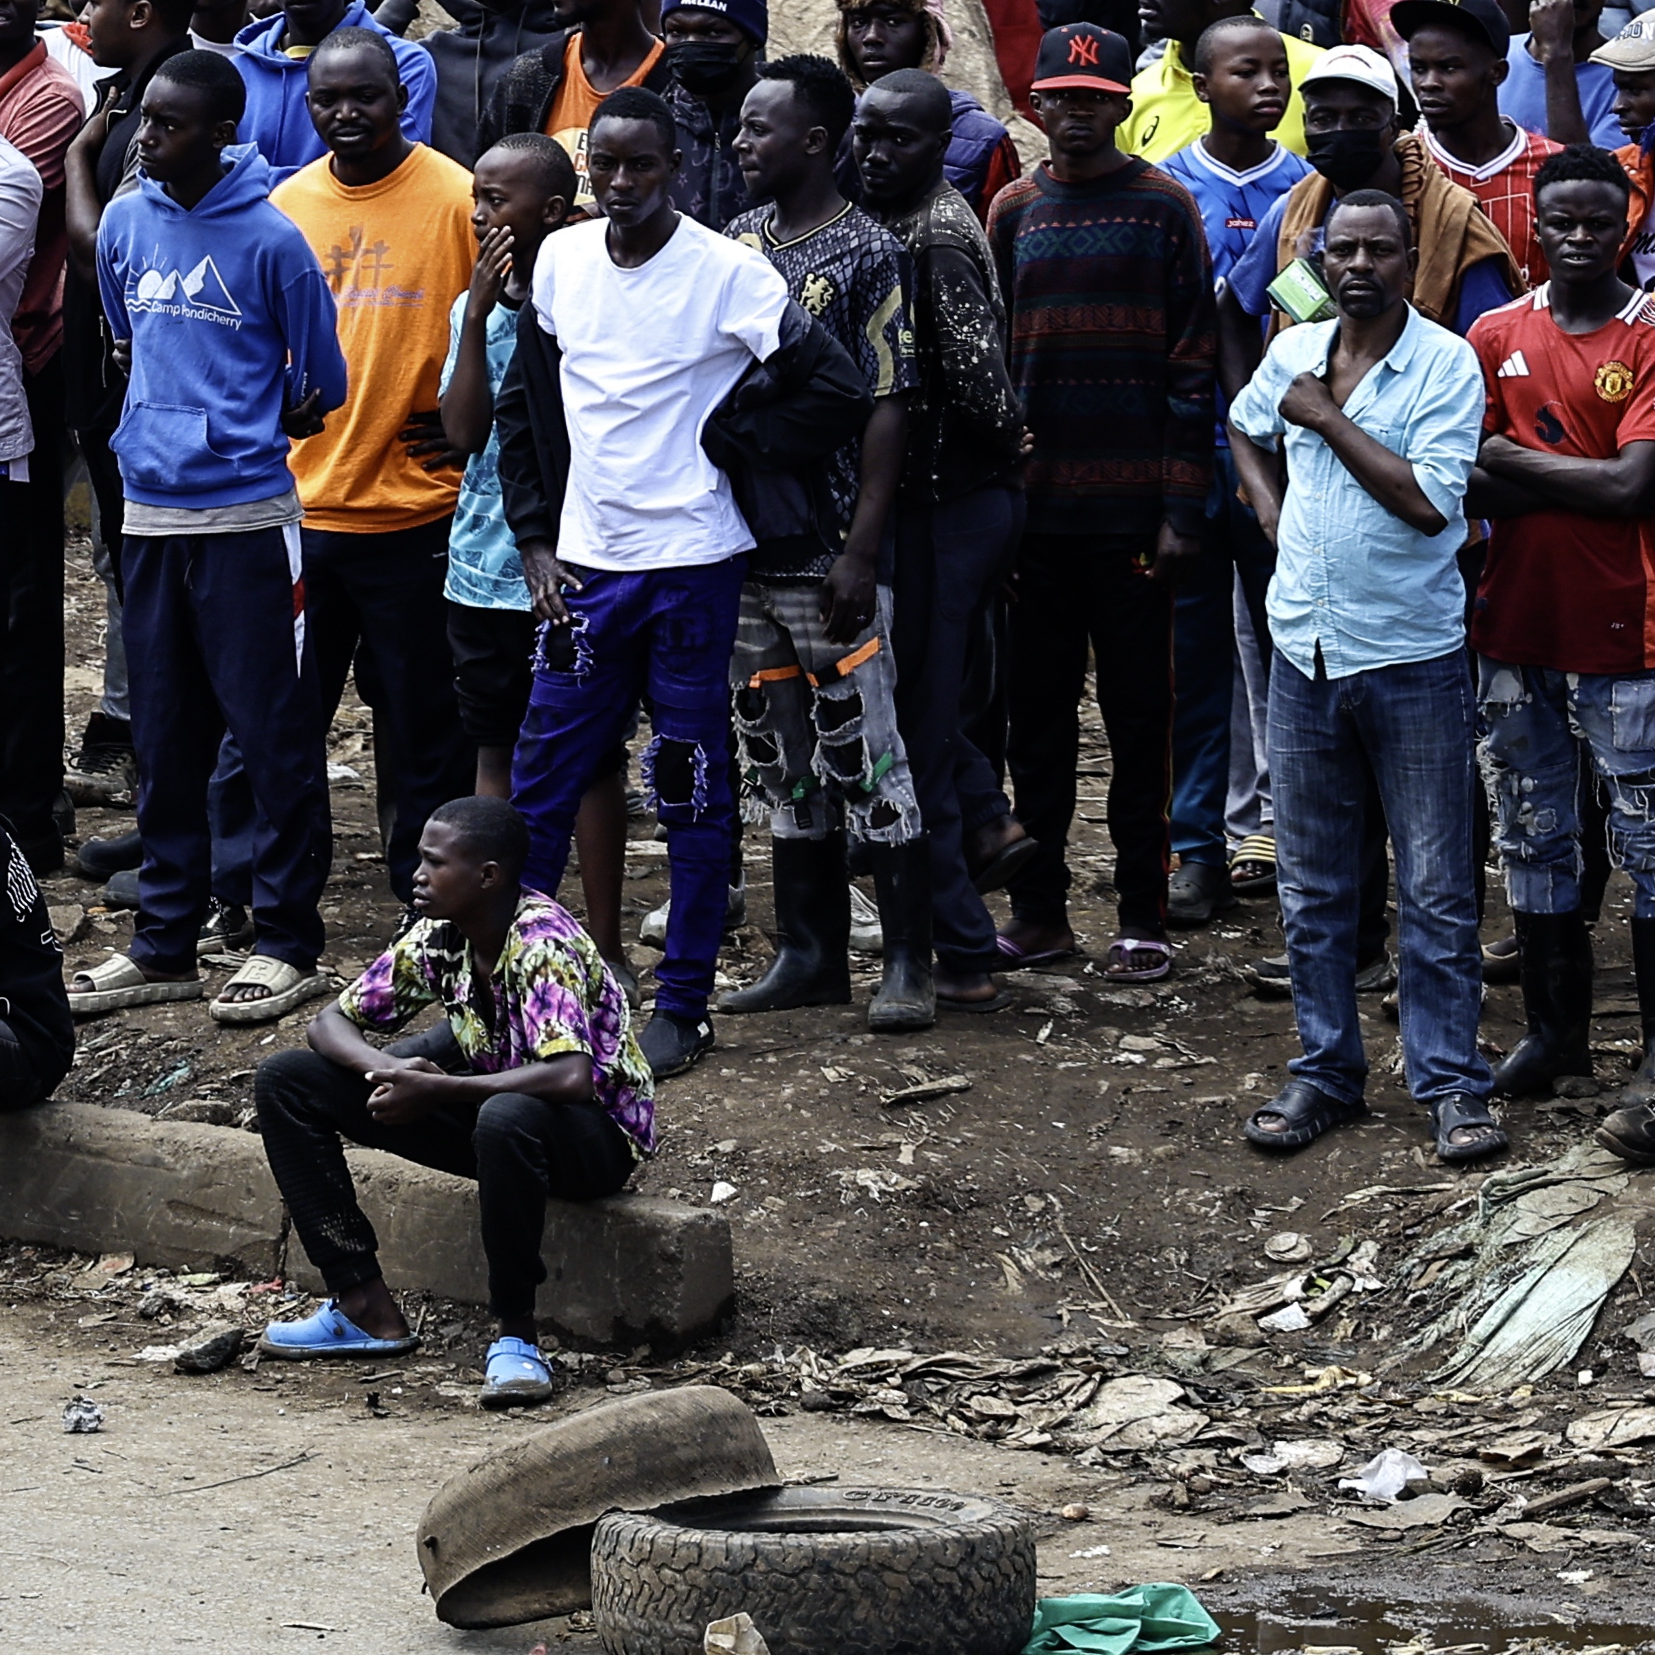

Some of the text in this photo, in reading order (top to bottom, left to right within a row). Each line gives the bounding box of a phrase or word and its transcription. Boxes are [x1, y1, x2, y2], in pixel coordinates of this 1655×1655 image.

[1067, 34, 1099, 66] NY
[150, 301, 242, 331] Camp Pondicherry
